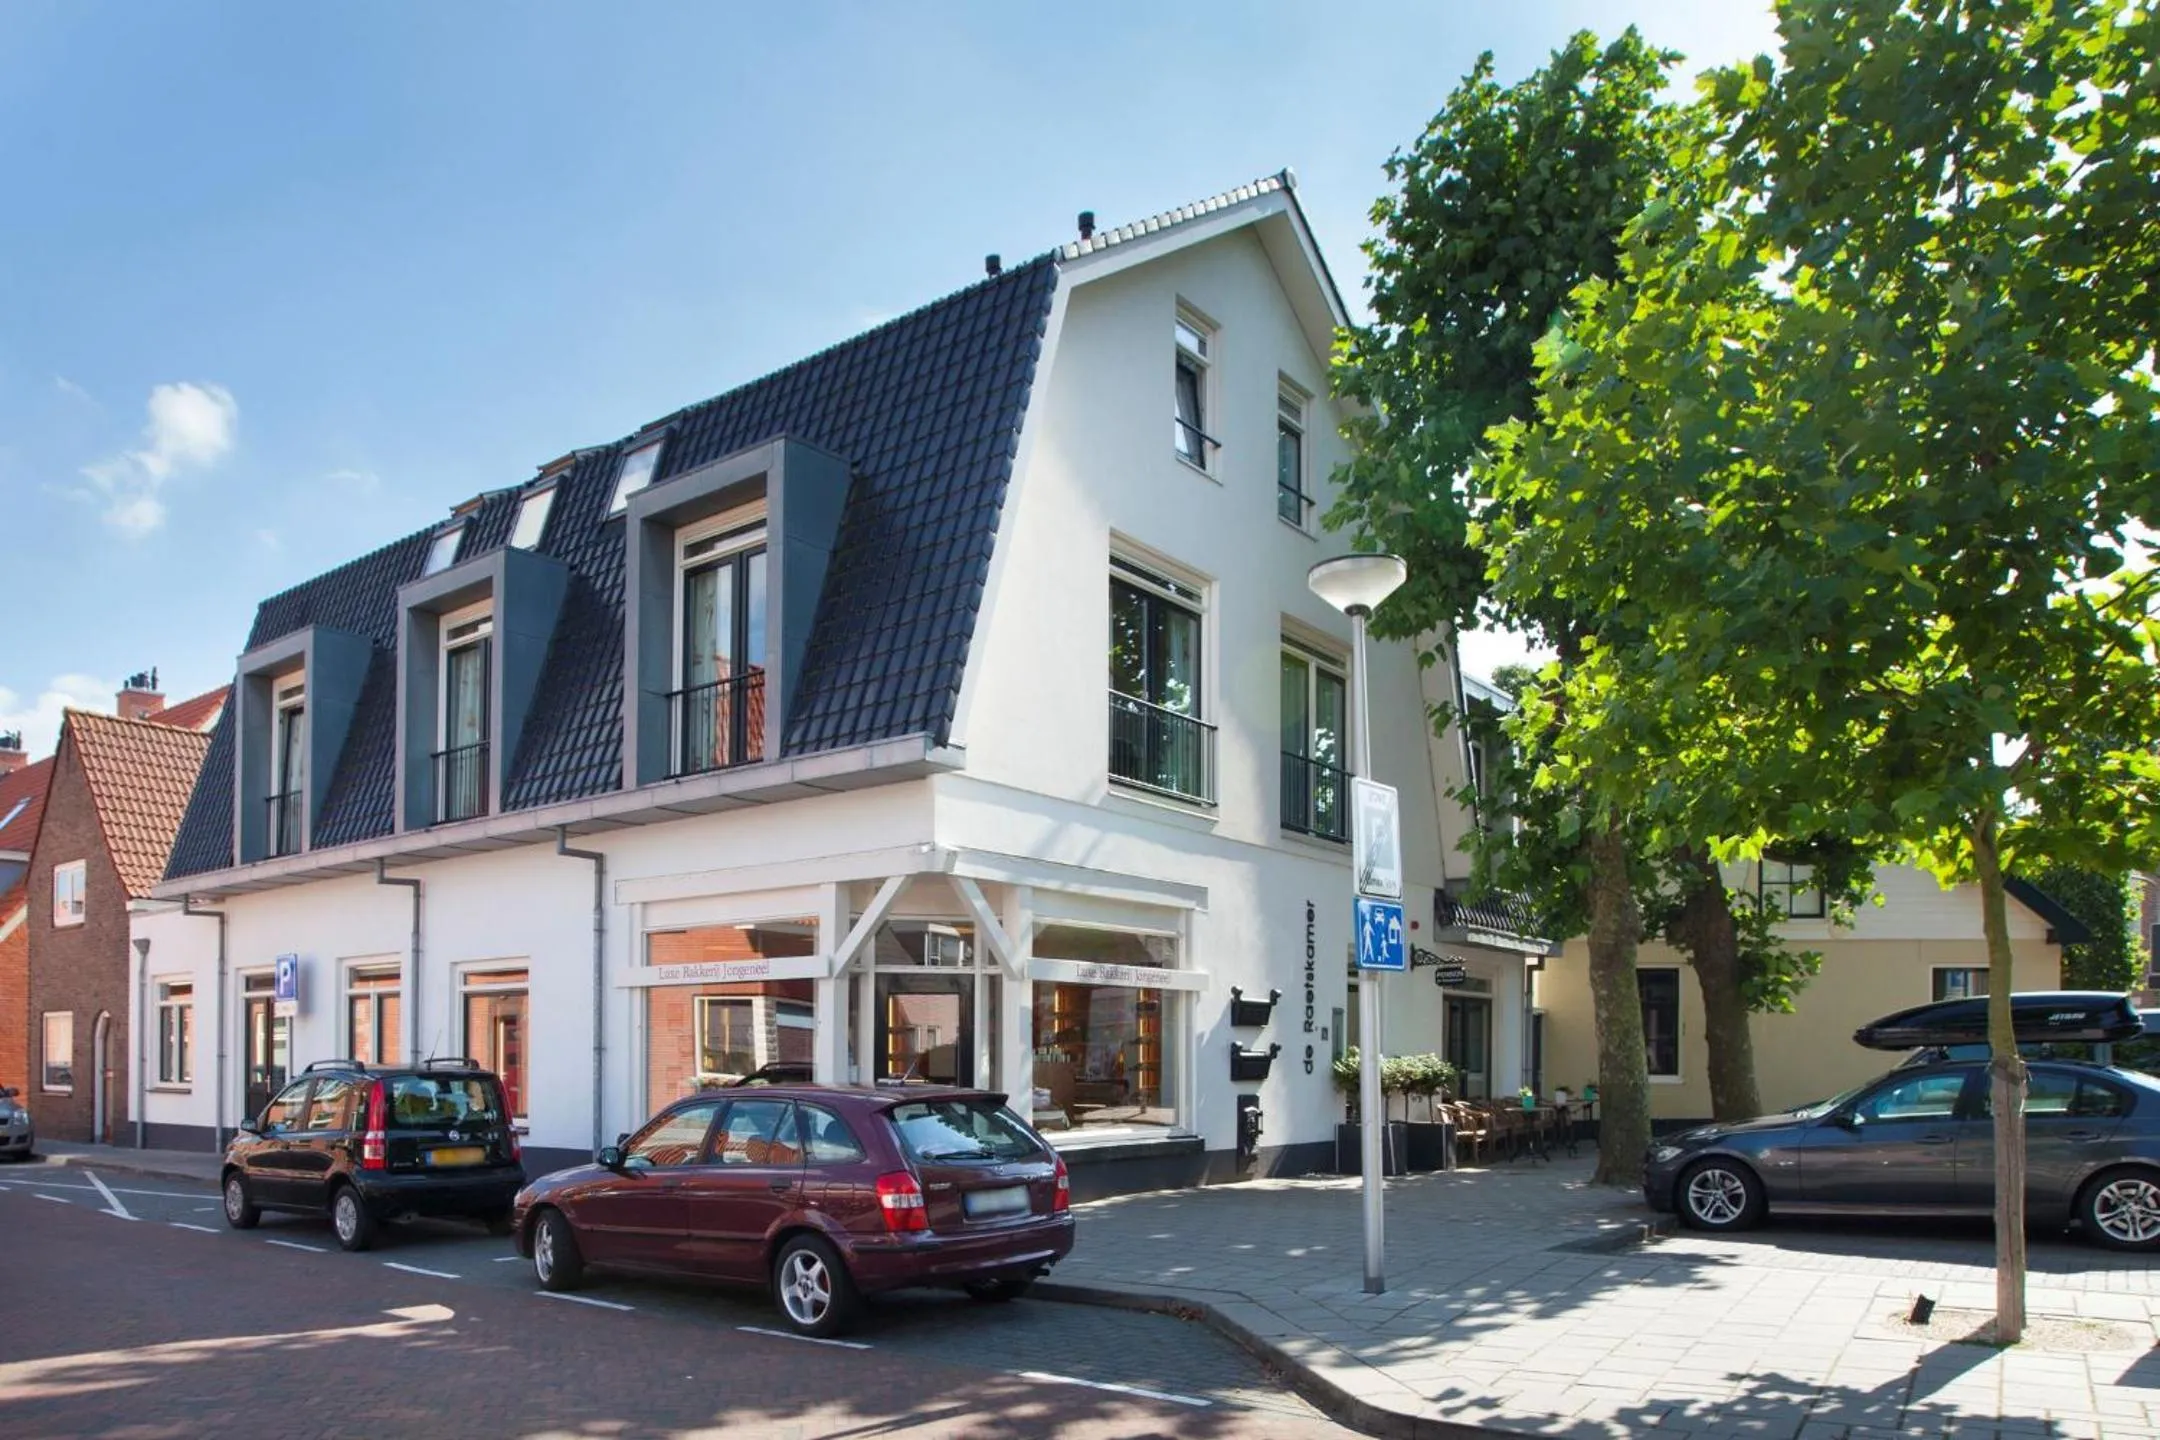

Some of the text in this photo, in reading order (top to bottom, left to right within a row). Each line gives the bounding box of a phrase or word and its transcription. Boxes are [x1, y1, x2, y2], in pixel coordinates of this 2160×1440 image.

[280, 961, 291, 995] P
[1303, 900, 1316, 1075] de Raetskamer
